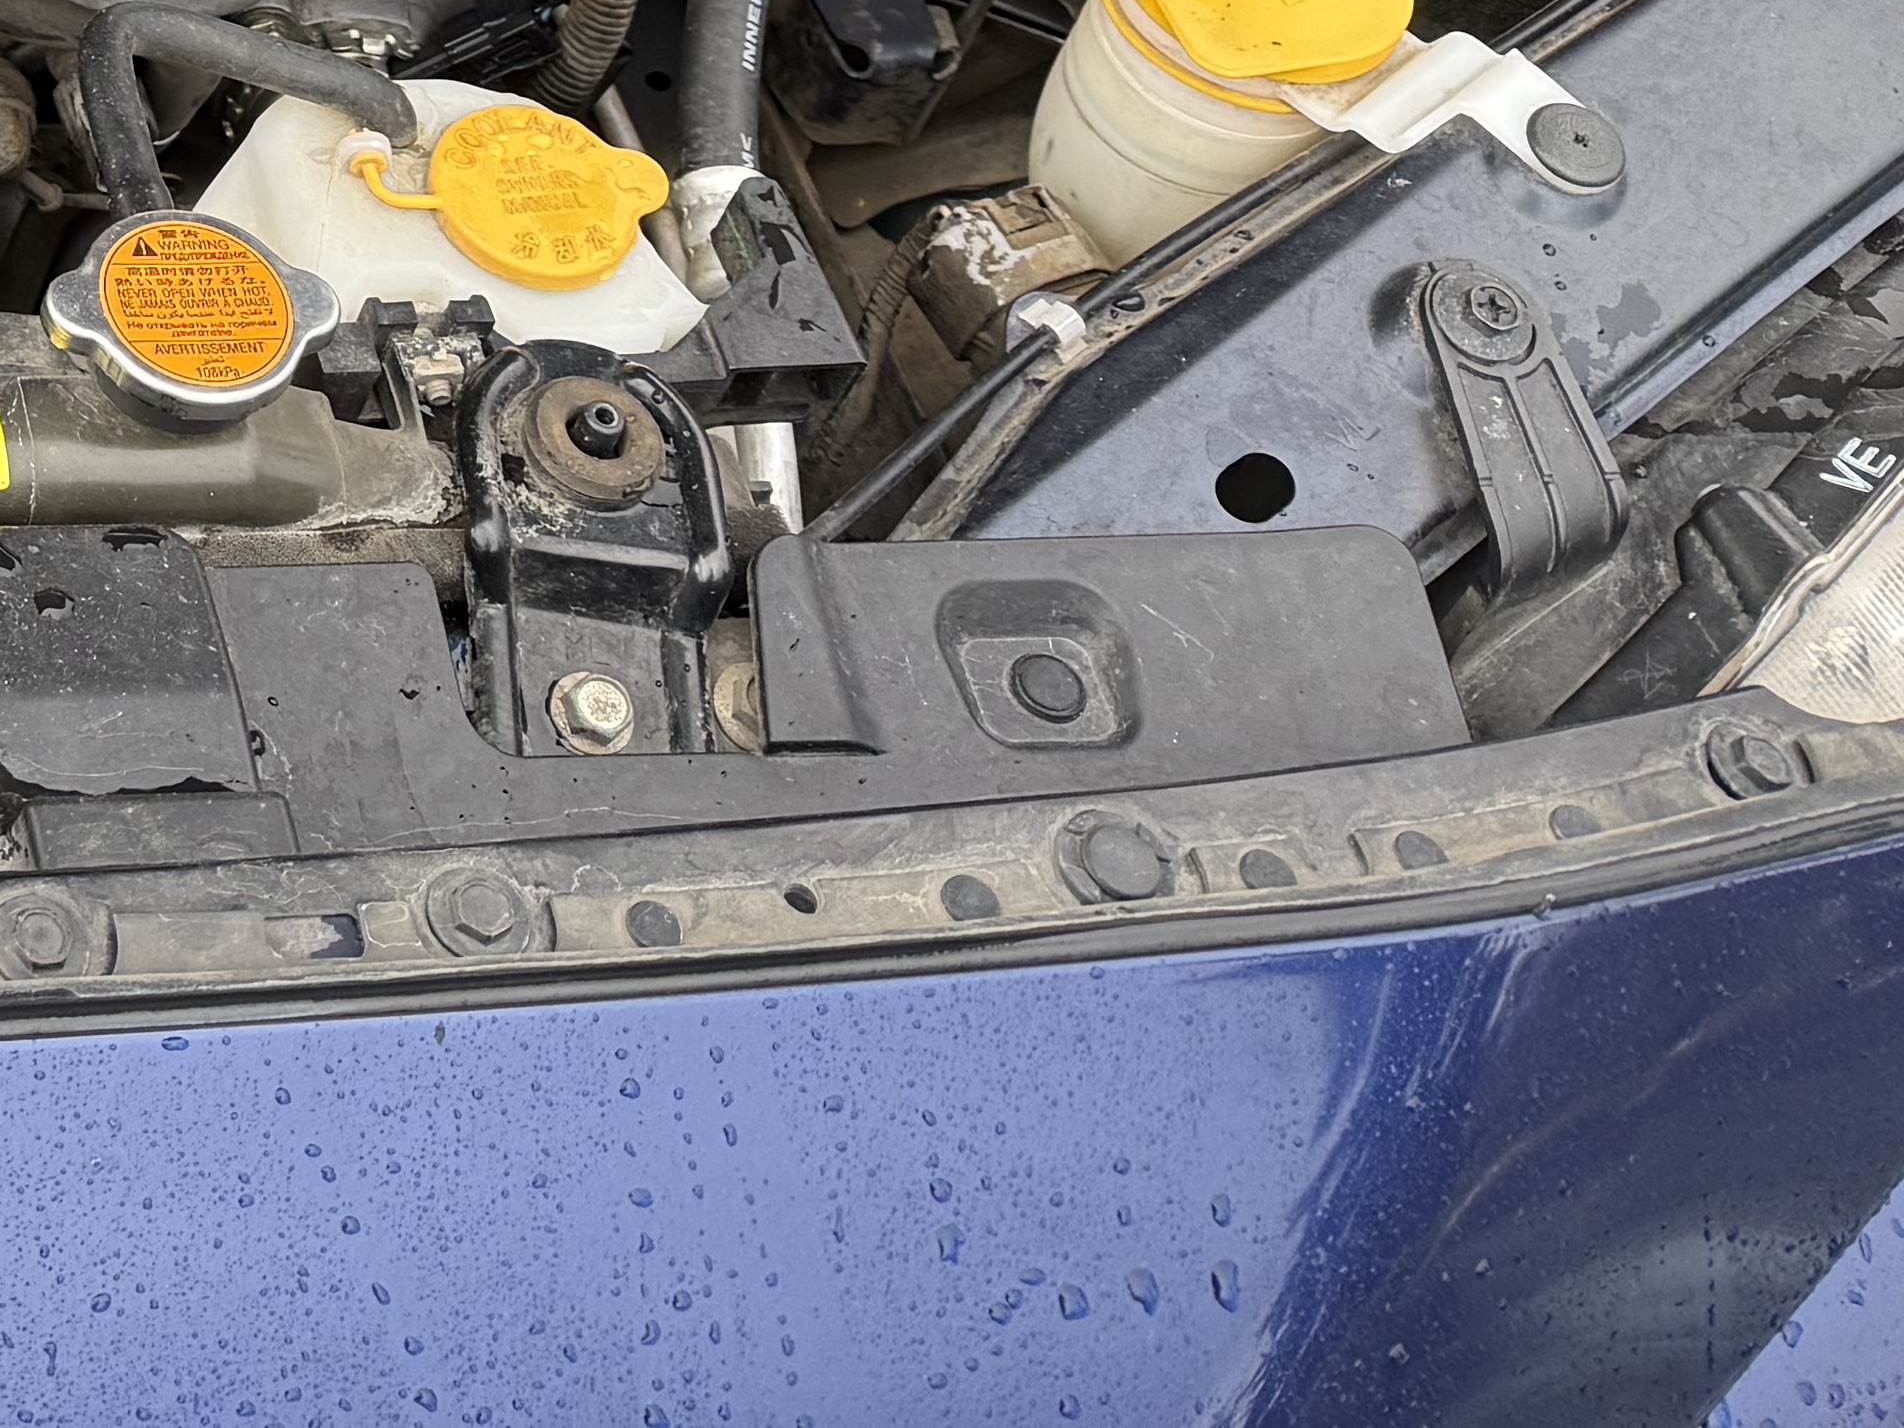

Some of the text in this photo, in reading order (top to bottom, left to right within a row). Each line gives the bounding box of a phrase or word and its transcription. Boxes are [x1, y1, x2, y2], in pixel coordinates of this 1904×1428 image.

[444, 112, 600, 169] COOLANT
[499, 154, 544, 175] SEE
[501, 190, 589, 215] MANUAL
[157, 239, 230, 251] WARNING
[117, 287, 157, 298] NEVER
[162, 287, 195, 298] OPEN
[199, 287, 238, 297] WHEN
[120, 298, 135, 310] NE
[138, 298, 176, 310] JAMAIS
[154, 341, 266, 355] AVERTISSEMENT
[1819, 436, 1897, 493] VE
